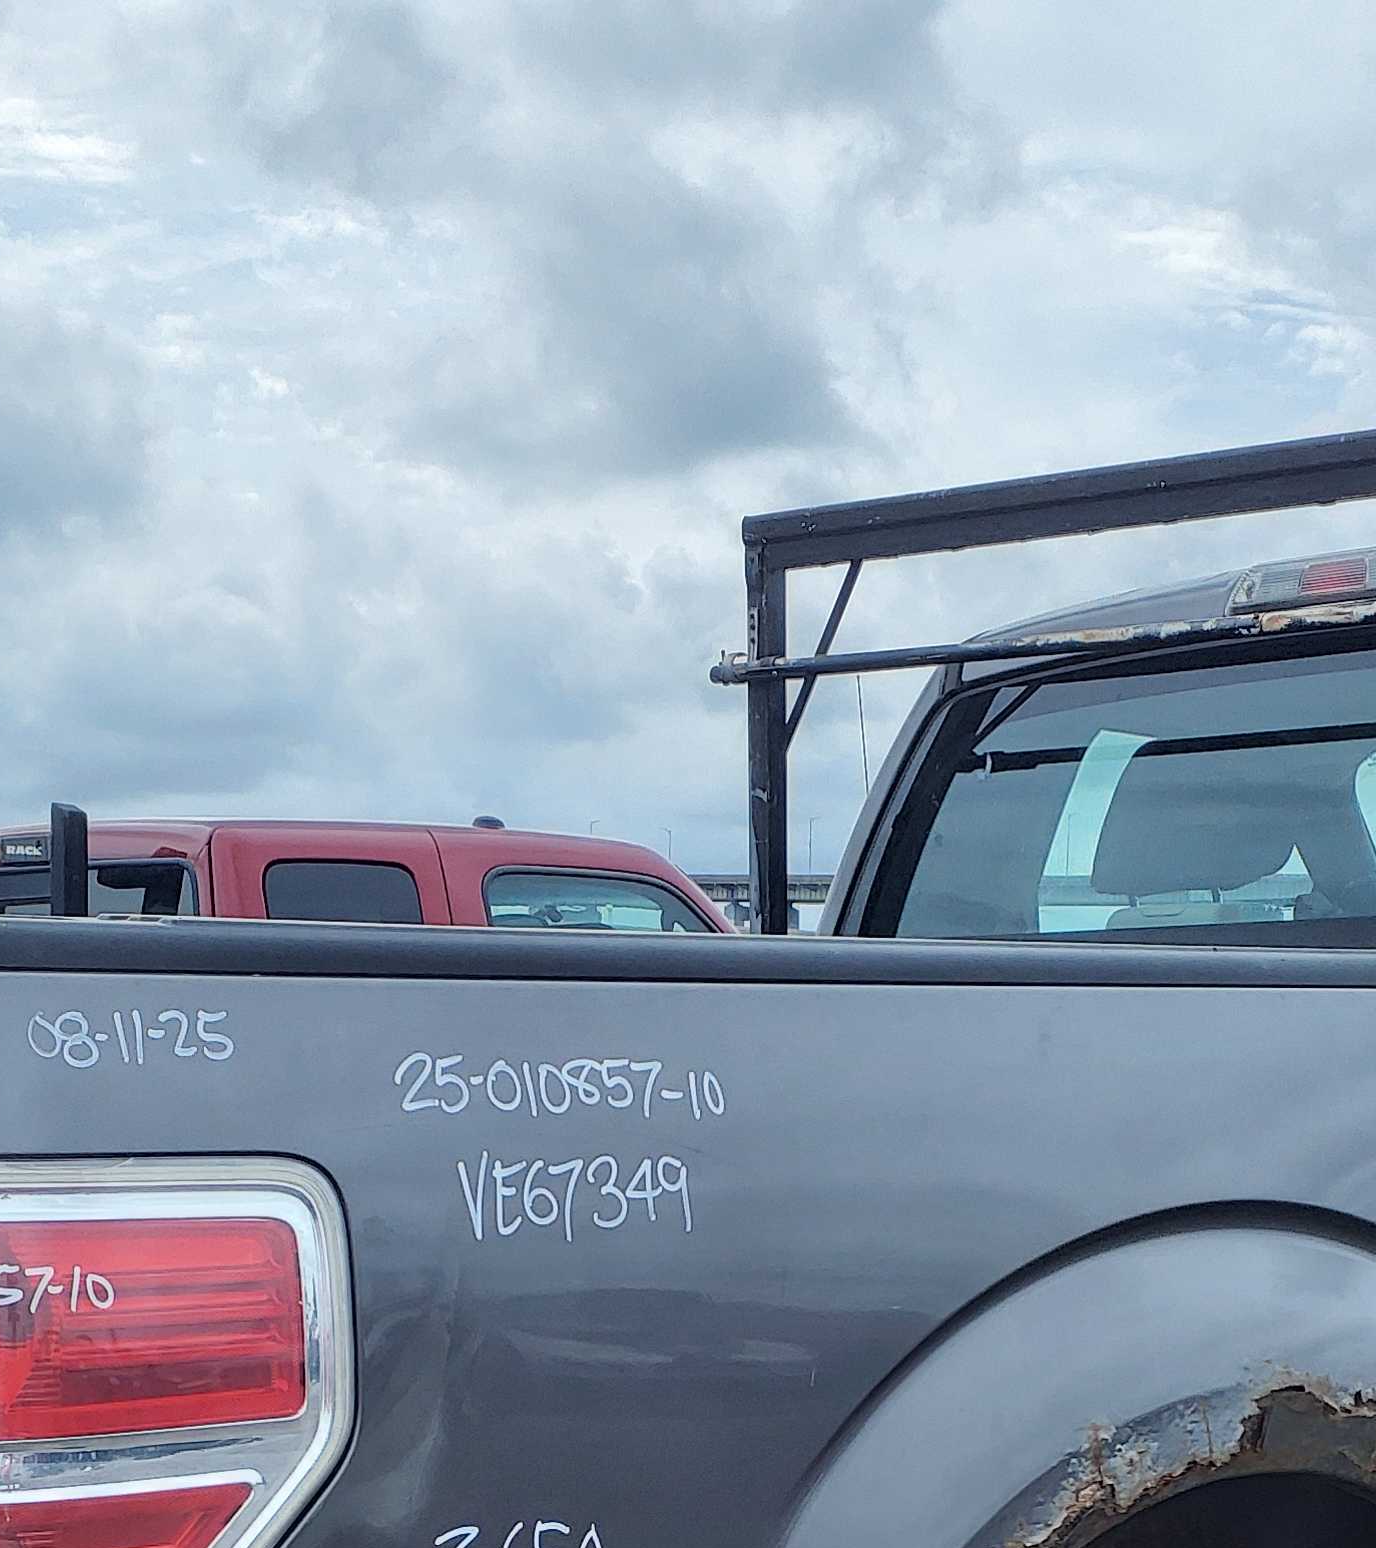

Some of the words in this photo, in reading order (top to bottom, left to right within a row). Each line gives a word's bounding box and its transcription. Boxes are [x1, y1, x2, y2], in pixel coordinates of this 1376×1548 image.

[6, 844, 42, 857] RACK
[26, 1009, 236, 1068] 08-11-25
[393, 1051, 726, 1120] 25-010857-10
[456, 1150, 692, 1242] VE67349
